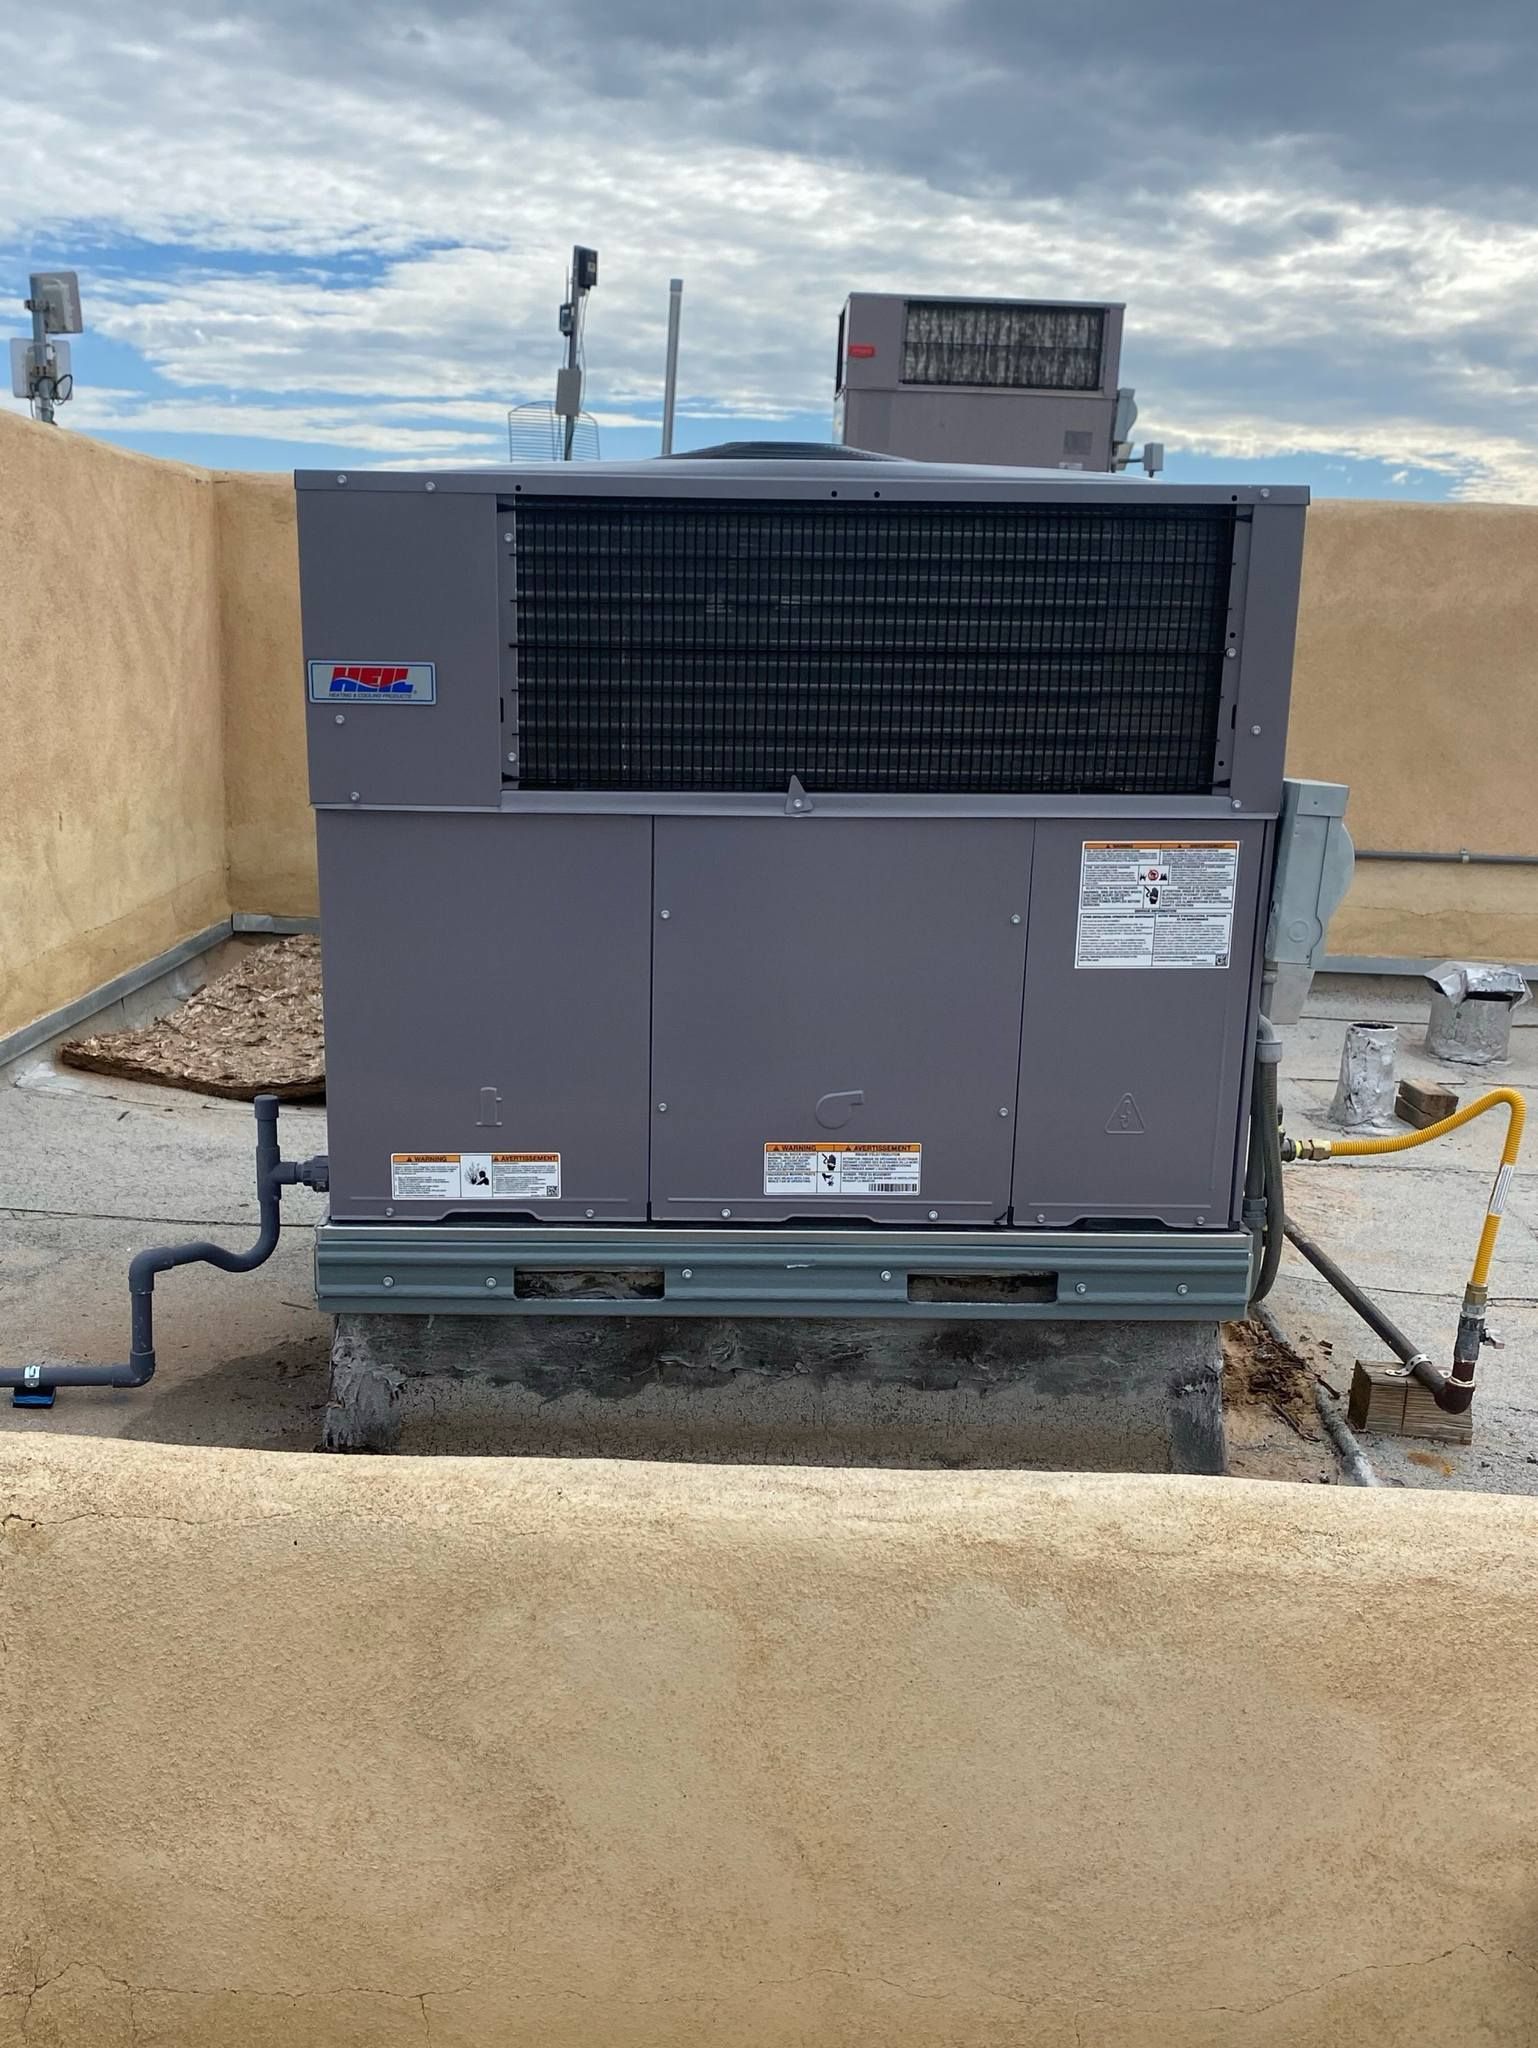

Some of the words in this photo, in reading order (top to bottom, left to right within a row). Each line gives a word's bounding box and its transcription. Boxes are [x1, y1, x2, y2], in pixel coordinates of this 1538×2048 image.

[329, 666, 414, 693] HEIL
[782, 1144, 816, 1152] WARNING
[854, 1144, 911, 1152] AVERTISSEMENT
